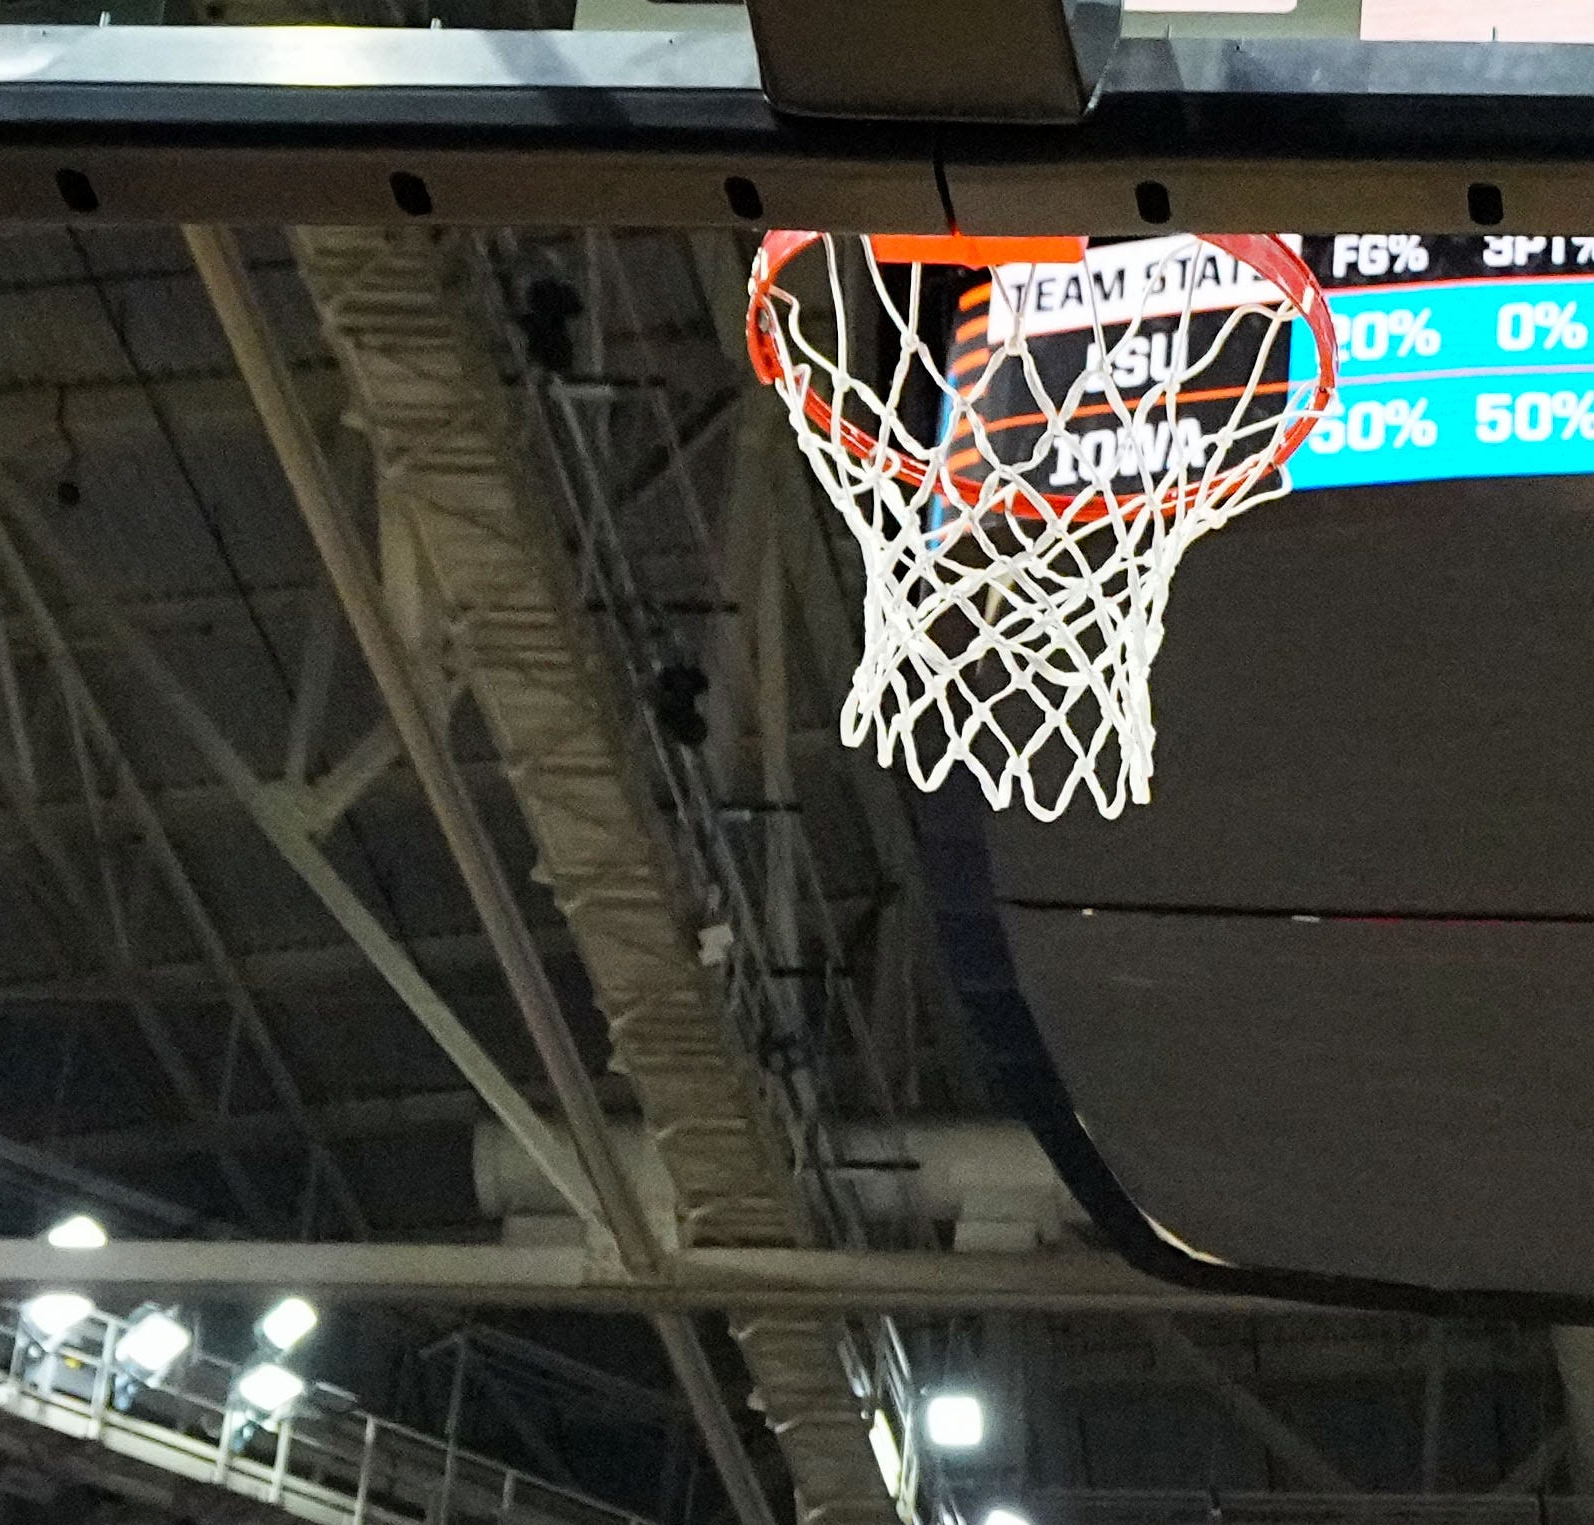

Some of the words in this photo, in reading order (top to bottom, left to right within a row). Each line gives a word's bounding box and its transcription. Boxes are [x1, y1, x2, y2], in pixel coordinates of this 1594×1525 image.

[1332, 235, 1429, 278] FG%
[1013, 262, 1126, 314] TEAM
[1085, 332, 1188, 394] LSU
[1496, 301, 1589, 352] 0%
[1048, 417, 1206, 487] IOWA
